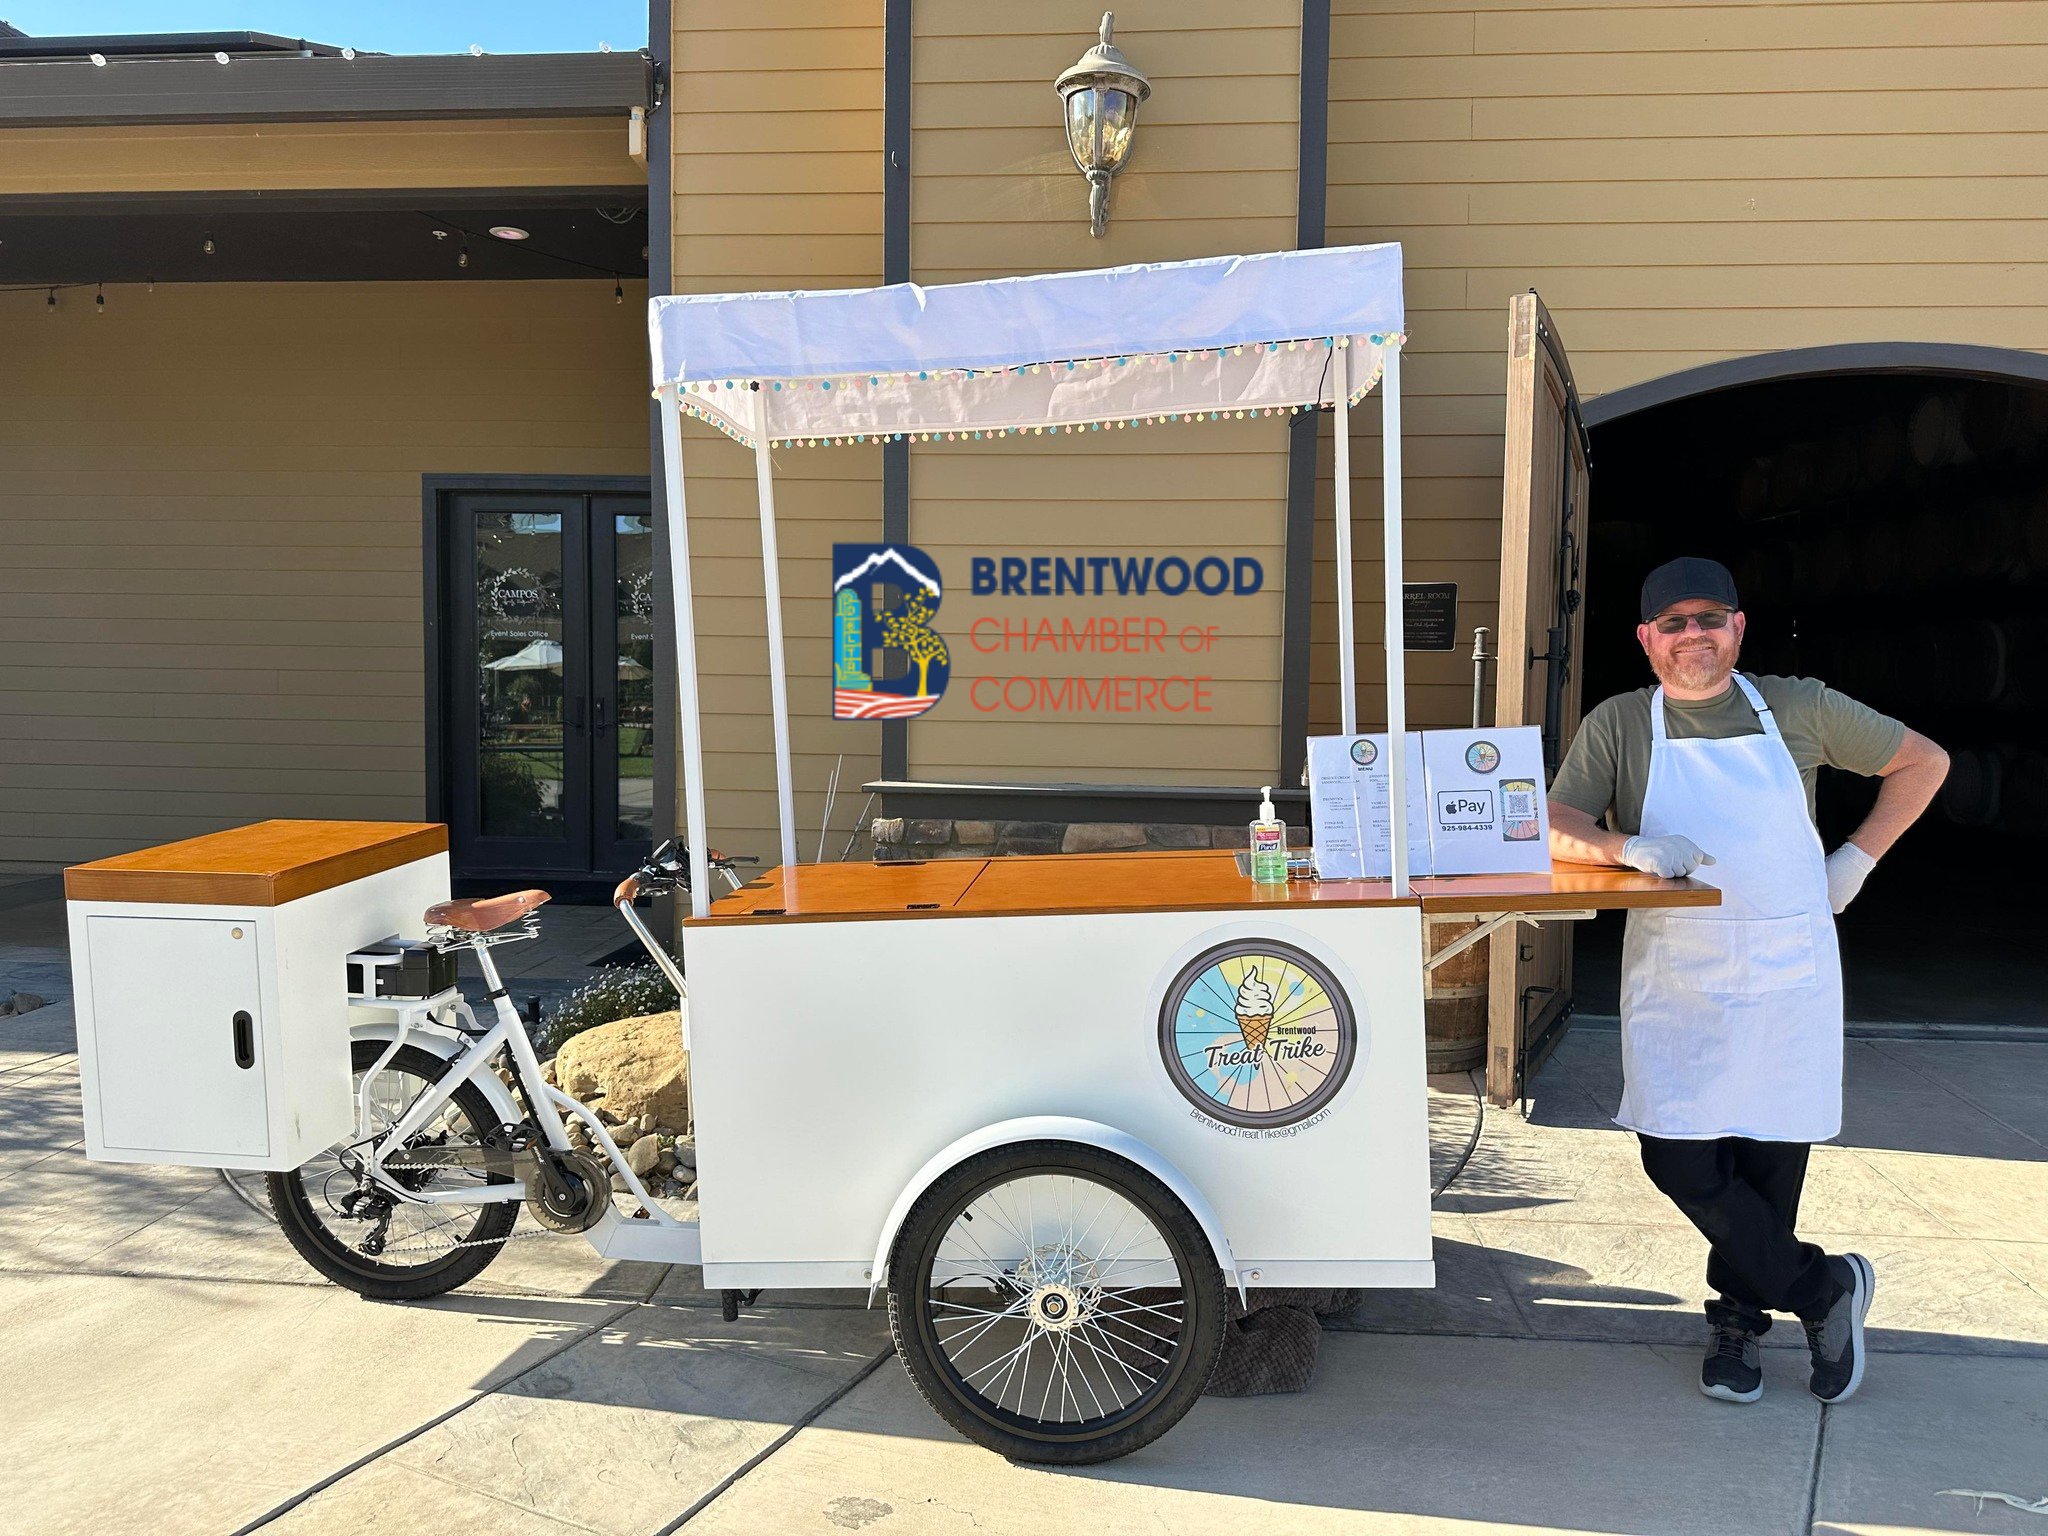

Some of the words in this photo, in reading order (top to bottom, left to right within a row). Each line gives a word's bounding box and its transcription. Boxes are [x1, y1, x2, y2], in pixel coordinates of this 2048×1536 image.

[498, 589, 538, 598] CAMPOS
[1403, 592, 1425, 600] RREL
[1427, 592, 1450, 600] ROOM
[491, 630, 509, 638] Event
[510, 630, 527, 638] Sales
[528, 630, 549, 638] Office
[1457, 799, 1486, 815] Pay
[1441, 824, 1493, 832] 925-984-4339
[1277, 1026, 1317, 1035] Brentwood
[1204, 1043, 1264, 1068] Treat
[1269, 1035, 1326, 1062] Trike
[1190, 1108, 1331, 1139] BrentwoodTreatTrike@gmail.com
